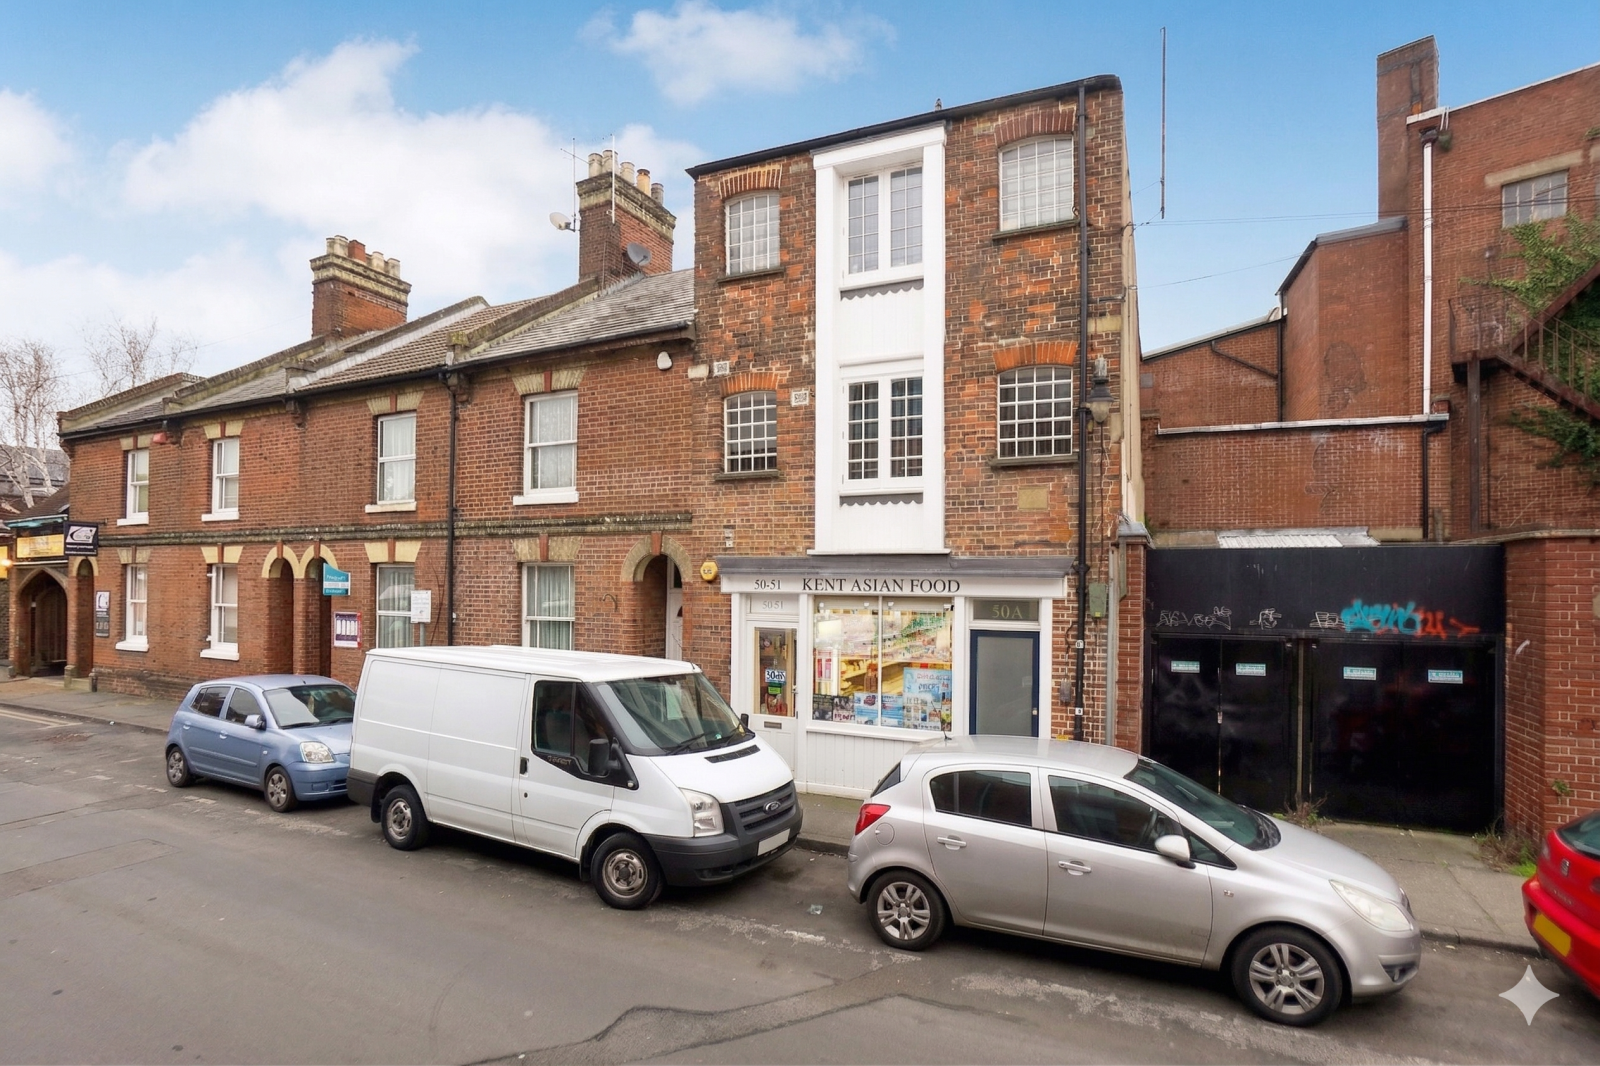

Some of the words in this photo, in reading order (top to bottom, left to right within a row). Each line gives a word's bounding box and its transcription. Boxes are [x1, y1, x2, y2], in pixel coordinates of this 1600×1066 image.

[754, 579, 781, 590] 50-51
[802, 578, 846, 591] KENT
[850, 578, 904, 592] ASIAN
[910, 579, 960, 593] FOOD
